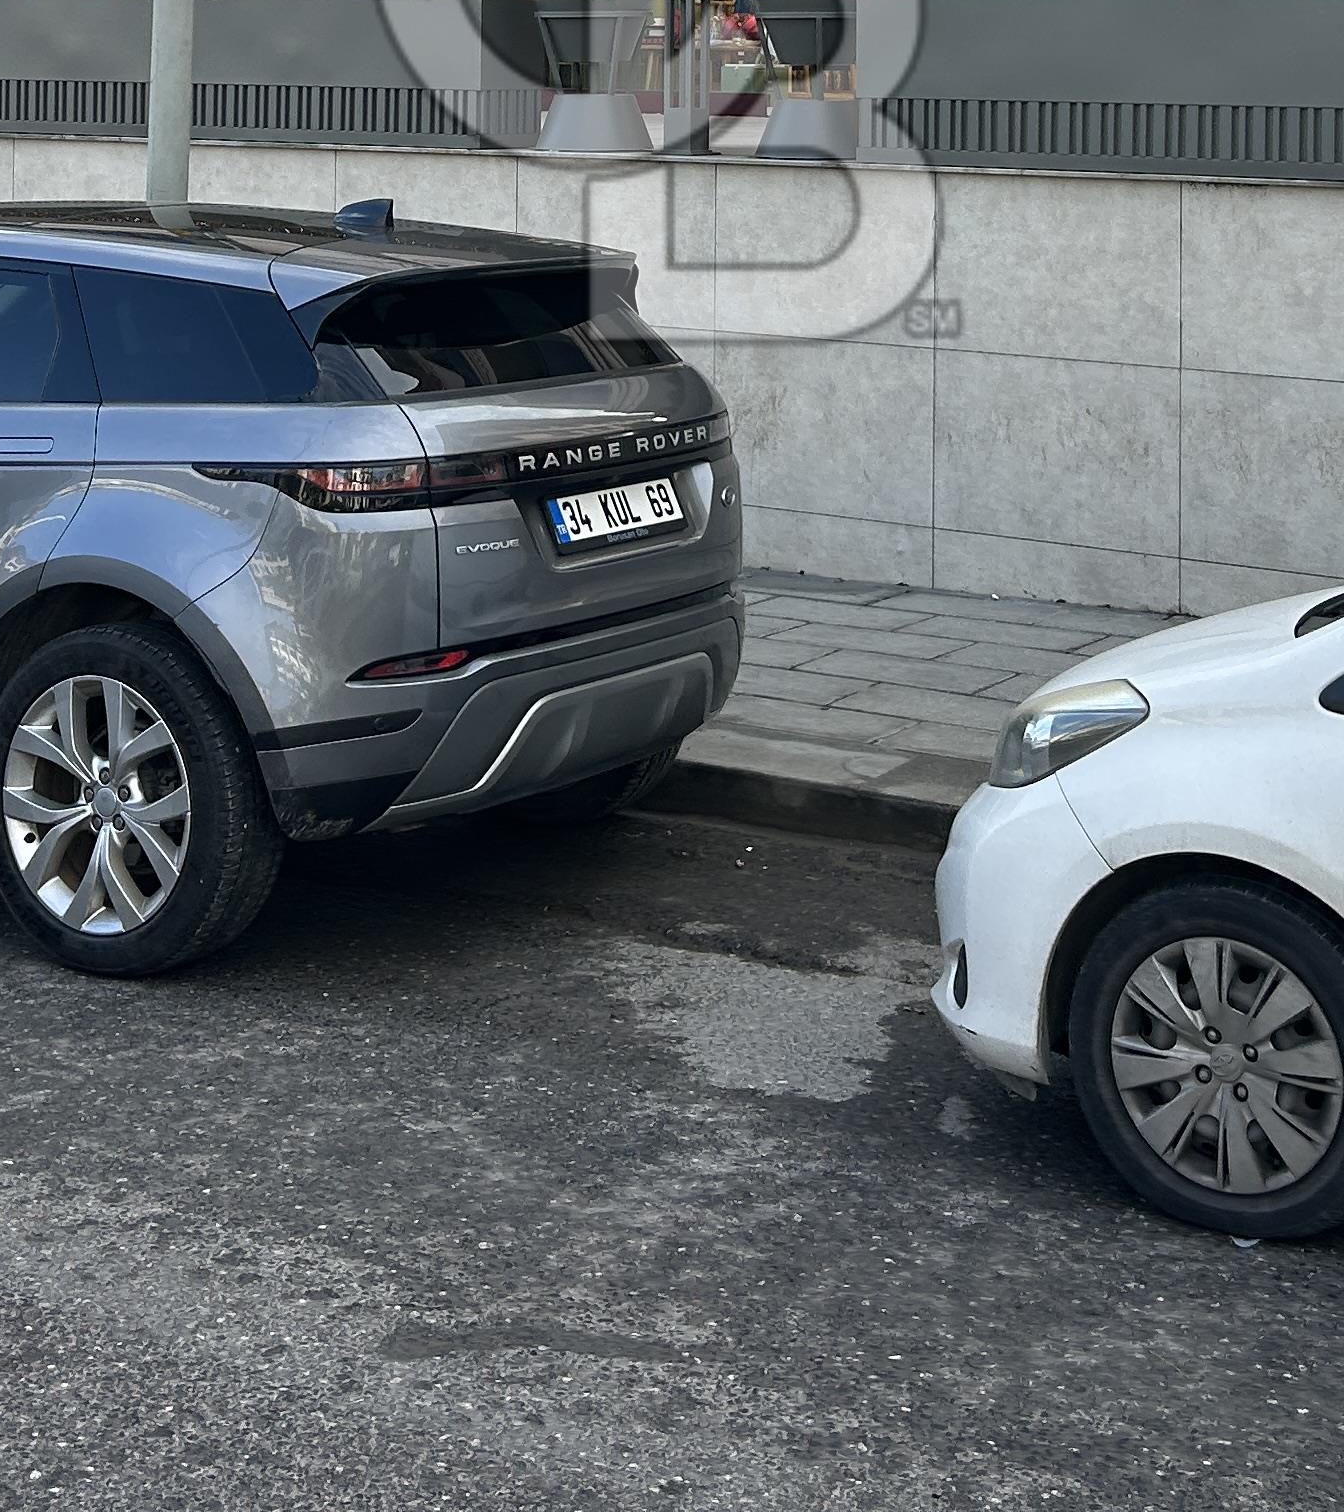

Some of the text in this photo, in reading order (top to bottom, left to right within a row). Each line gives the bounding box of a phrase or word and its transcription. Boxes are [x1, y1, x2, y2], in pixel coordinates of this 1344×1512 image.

[518, 425, 709, 472] RANGE ROVER
[562, 499, 593, 535] 34
[598, 490, 642, 528] KUL
[645, 483, 675, 518] 69
[456, 538, 520, 554] EVOQUE
